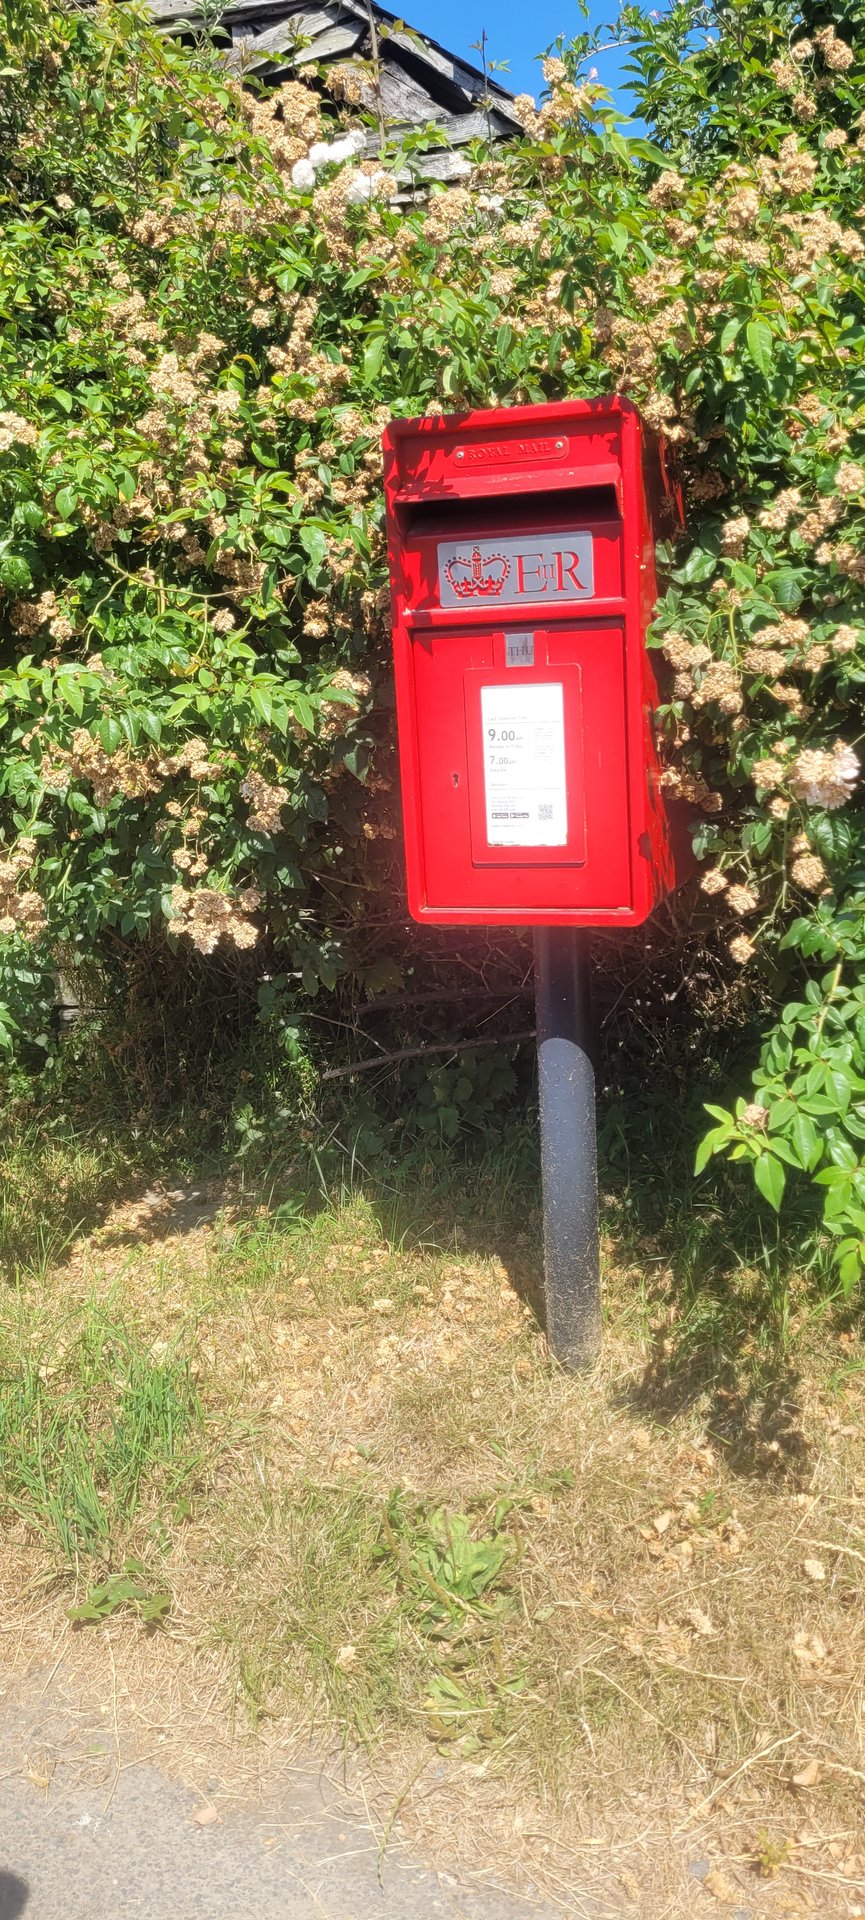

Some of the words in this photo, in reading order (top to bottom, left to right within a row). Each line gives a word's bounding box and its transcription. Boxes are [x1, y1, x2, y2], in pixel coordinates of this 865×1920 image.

[467, 445, 511, 460] ROYAL
[518, 442, 551, 455] MAIL
[508, 645, 534, 656] THU
